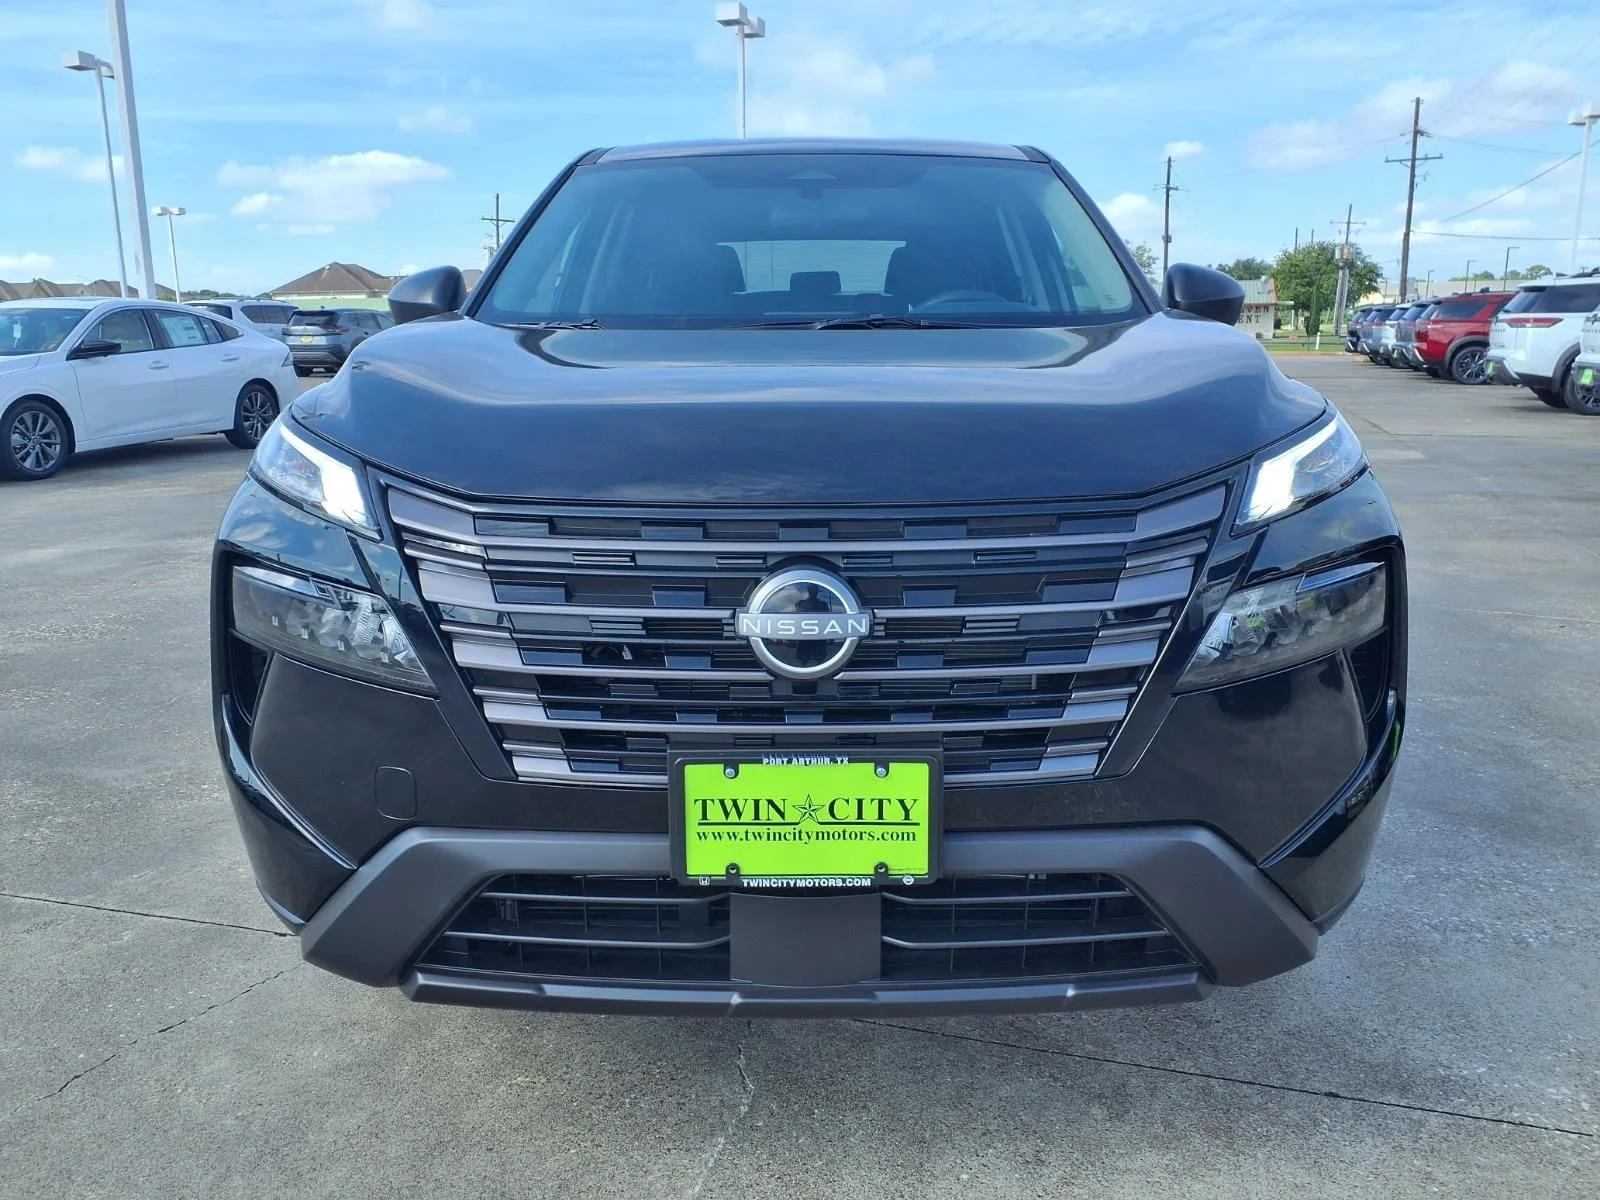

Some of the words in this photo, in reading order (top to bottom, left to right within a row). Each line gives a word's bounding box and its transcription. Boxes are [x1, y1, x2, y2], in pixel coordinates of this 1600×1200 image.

[743, 618, 866, 635] NISSAN
[762, 756, 788, 766] PORT
[836, 756, 849, 766] TX
[694, 798, 788, 821] TWIN
[828, 797, 919, 821] CITY
[696, 828, 916, 844] www.twincitymotors.com
[742, 877, 871, 888] TWINCITYMOTORS.COM
